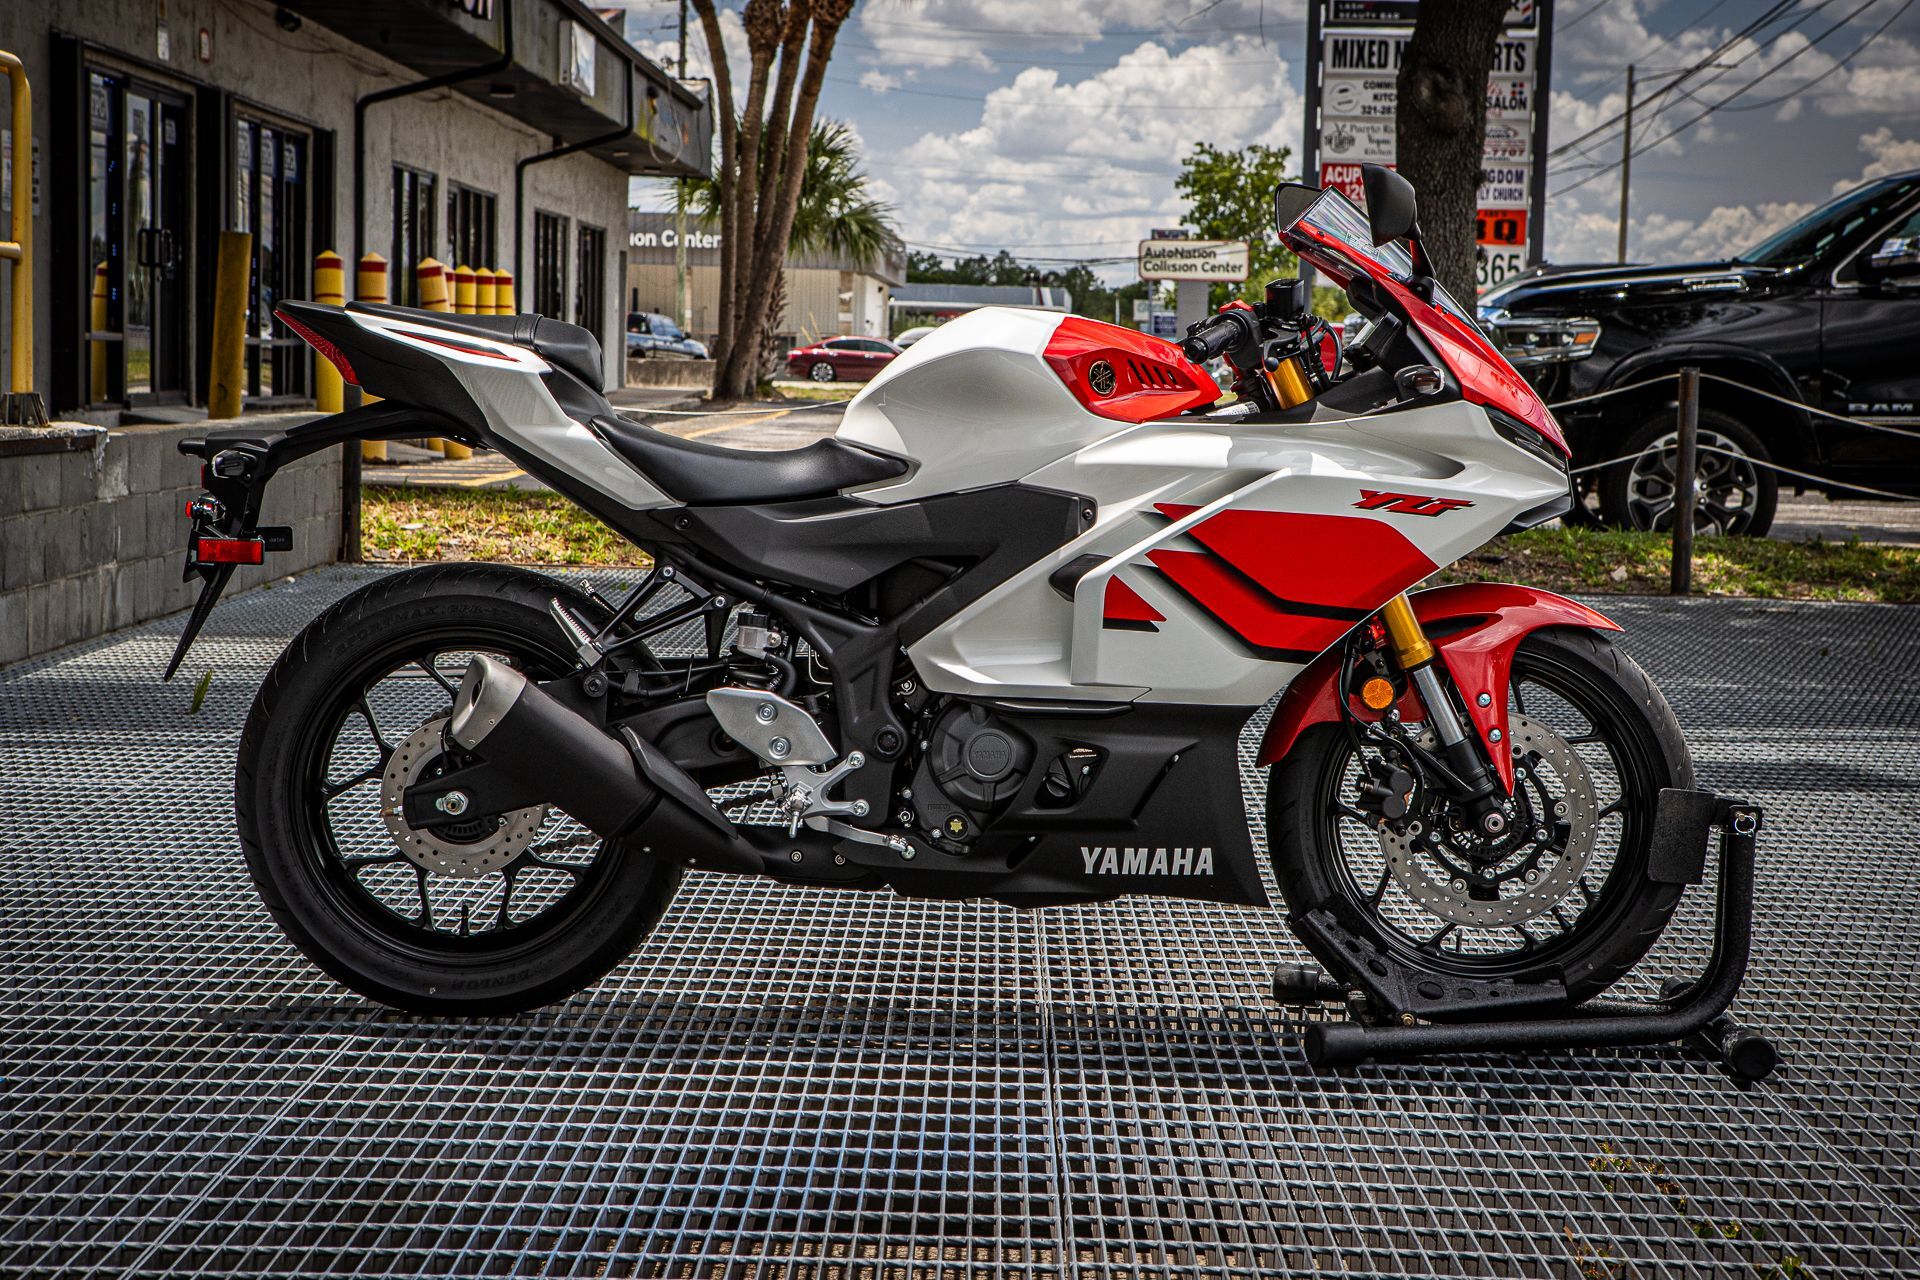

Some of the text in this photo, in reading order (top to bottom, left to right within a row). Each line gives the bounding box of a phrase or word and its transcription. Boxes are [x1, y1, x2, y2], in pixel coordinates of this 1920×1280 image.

[1332, 38, 1389, 69] MIXED
[1492, 42, 1525, 72] RTS
[1363, 80, 1394, 90] COMM
[1373, 93, 1396, 102] KITC
[1486, 95, 1527, 110] SALON
[1325, 166, 1363, 183] ACUP
[1484, 169, 1524, 184] GDOM
[1493, 187, 1524, 201] CHURCH
[629, 232, 656, 247] ion
[1144, 247, 1217, 259] AutoNation
[1143, 260, 1243, 273] Collision Center
[1848, 403, 1913, 412] RAM
[1081, 847, 1213, 875] YAMAHA
